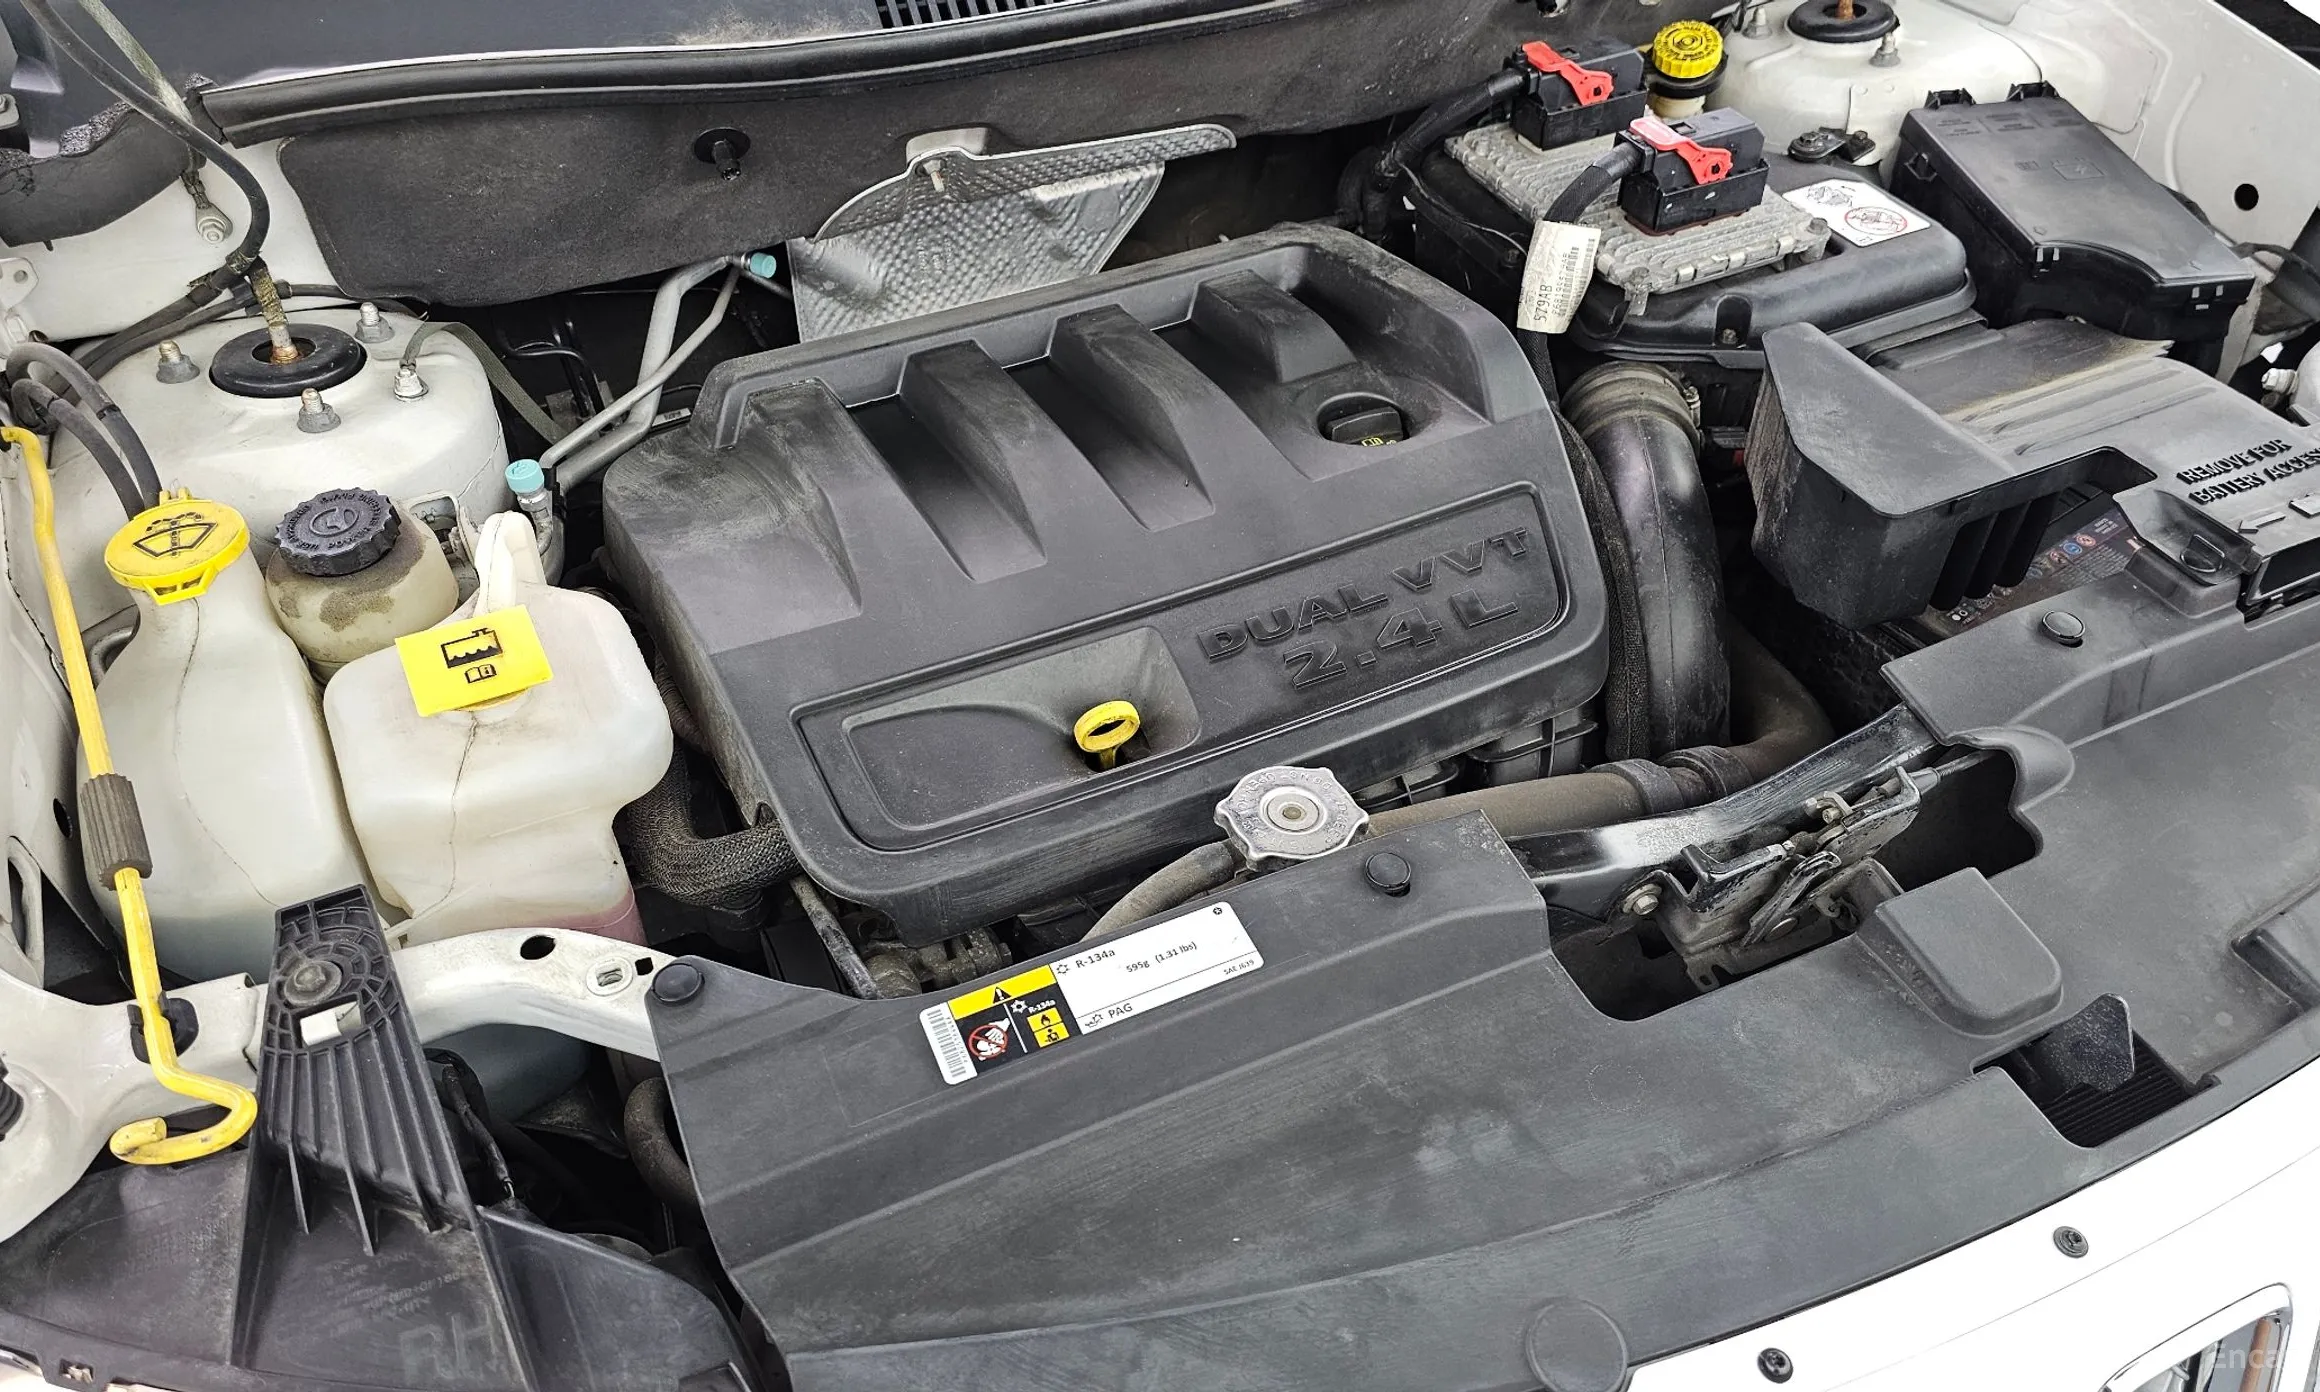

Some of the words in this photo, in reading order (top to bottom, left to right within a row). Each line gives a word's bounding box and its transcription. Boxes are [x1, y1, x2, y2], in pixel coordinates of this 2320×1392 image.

[2176, 453, 2256, 486] REMOVE
[2247, 439, 2292, 462] FOR
[2188, 472, 2266, 506] BATTERY
[2263, 447, 2320, 482] ACCES
[1197, 583, 1389, 663] DUAL
[1391, 526, 1528, 592] VVT
[1074, 948, 1116, 969] R-134a
[1126, 960, 1150, 973] 595g
[1155, 948, 1180, 964] (1.31
[1179, 940, 1198, 954] lbs)
[1223, 965, 1238, 975] SAE
[1238, 959, 1255, 970] J639
[1107, 1002, 1134, 1019] PAG
